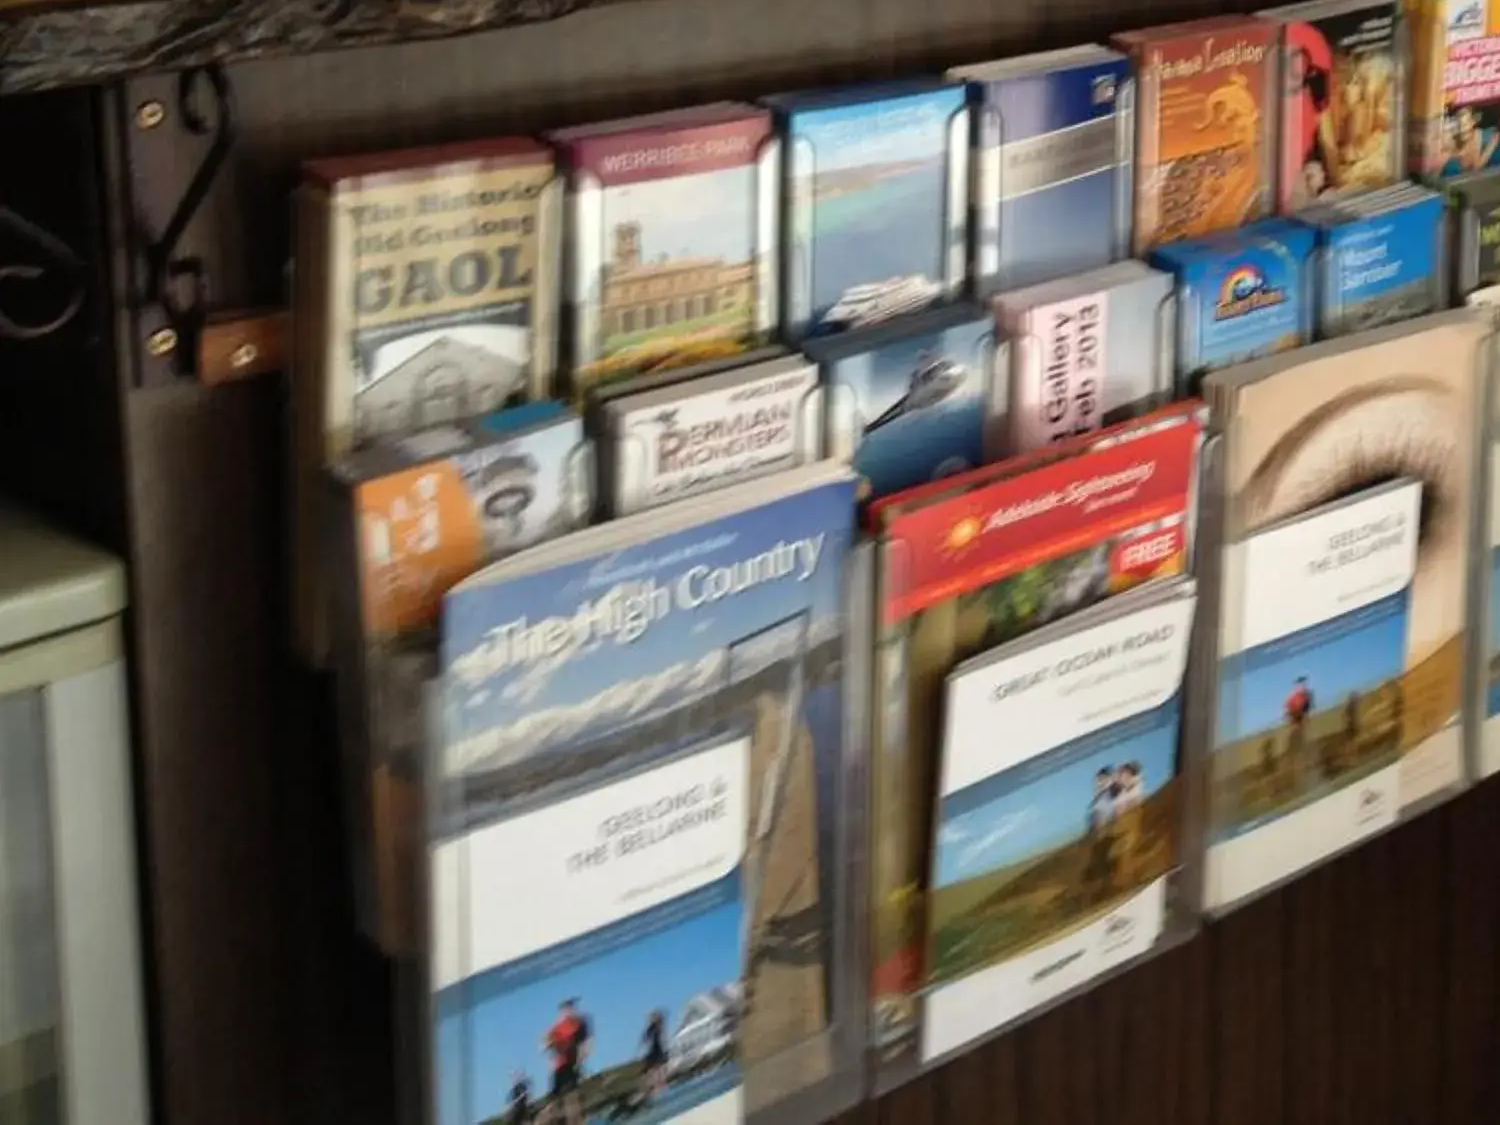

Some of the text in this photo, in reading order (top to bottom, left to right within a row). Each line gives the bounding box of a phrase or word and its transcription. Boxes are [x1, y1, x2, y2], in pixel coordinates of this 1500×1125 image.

[604, 144, 699, 172] WERRIBEE
[352, 183, 541, 226] The Historic
[408, 212, 536, 246] Geelong
[354, 244, 534, 315] GAOL
[1045, 313, 1071, 423] Gallery
[1078, 303, 1099, 372] 2013
[659, 399, 791, 474] PERMIAN
[1119, 531, 1178, 570] FREE
[483, 530, 825, 661] The High Country
[1055, 639, 1118, 678] OCEAN
[1120, 624, 1177, 654] ROAD
[566, 798, 729, 874] THE BELLARINE
[597, 783, 705, 837] GEELONG
